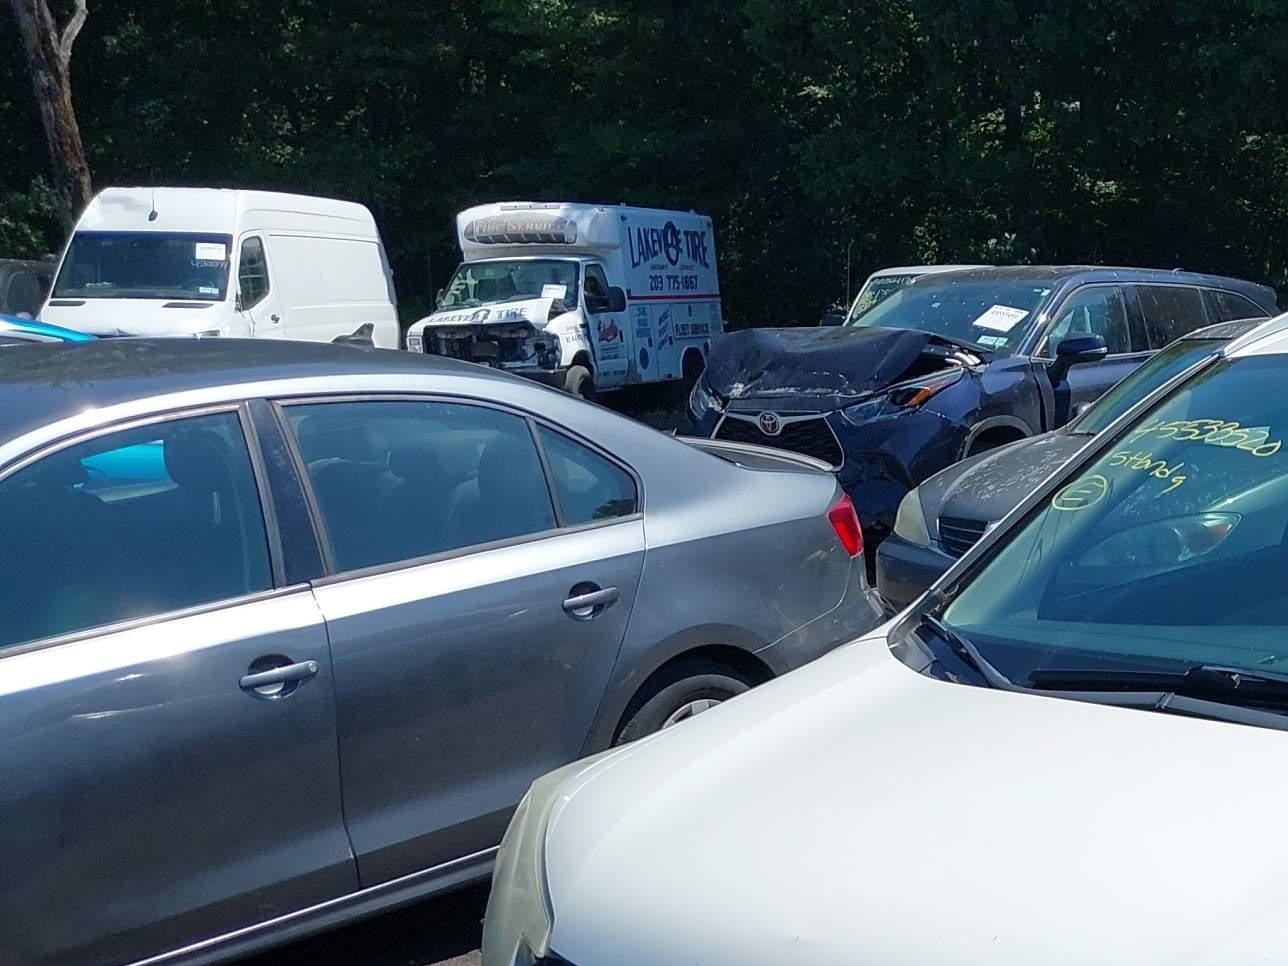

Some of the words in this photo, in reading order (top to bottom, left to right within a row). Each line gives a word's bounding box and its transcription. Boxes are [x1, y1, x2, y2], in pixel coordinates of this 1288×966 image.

[684, 230, 709, 269] TIRE
[649, 274, 664, 291] 203
[496, 307, 528, 320] TIRE
